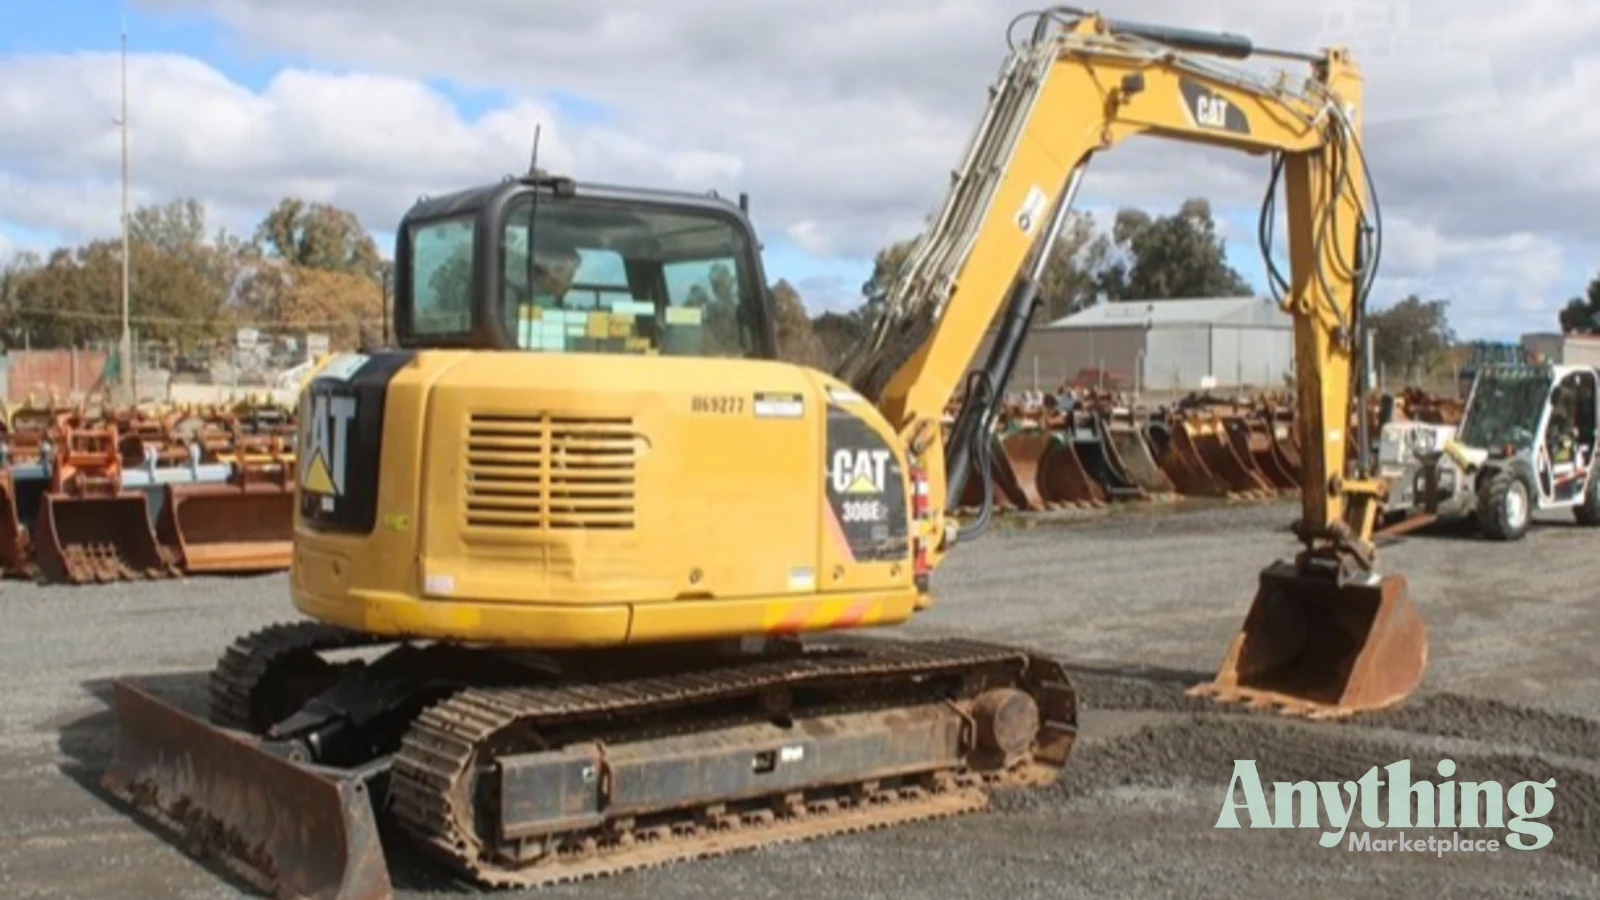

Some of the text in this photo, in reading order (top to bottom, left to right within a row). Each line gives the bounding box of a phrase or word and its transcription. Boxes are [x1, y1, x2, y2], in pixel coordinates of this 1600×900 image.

[1198, 95, 1228, 127] CAT
[301, 394, 357, 497] AT
[833, 449, 890, 494] CAT
